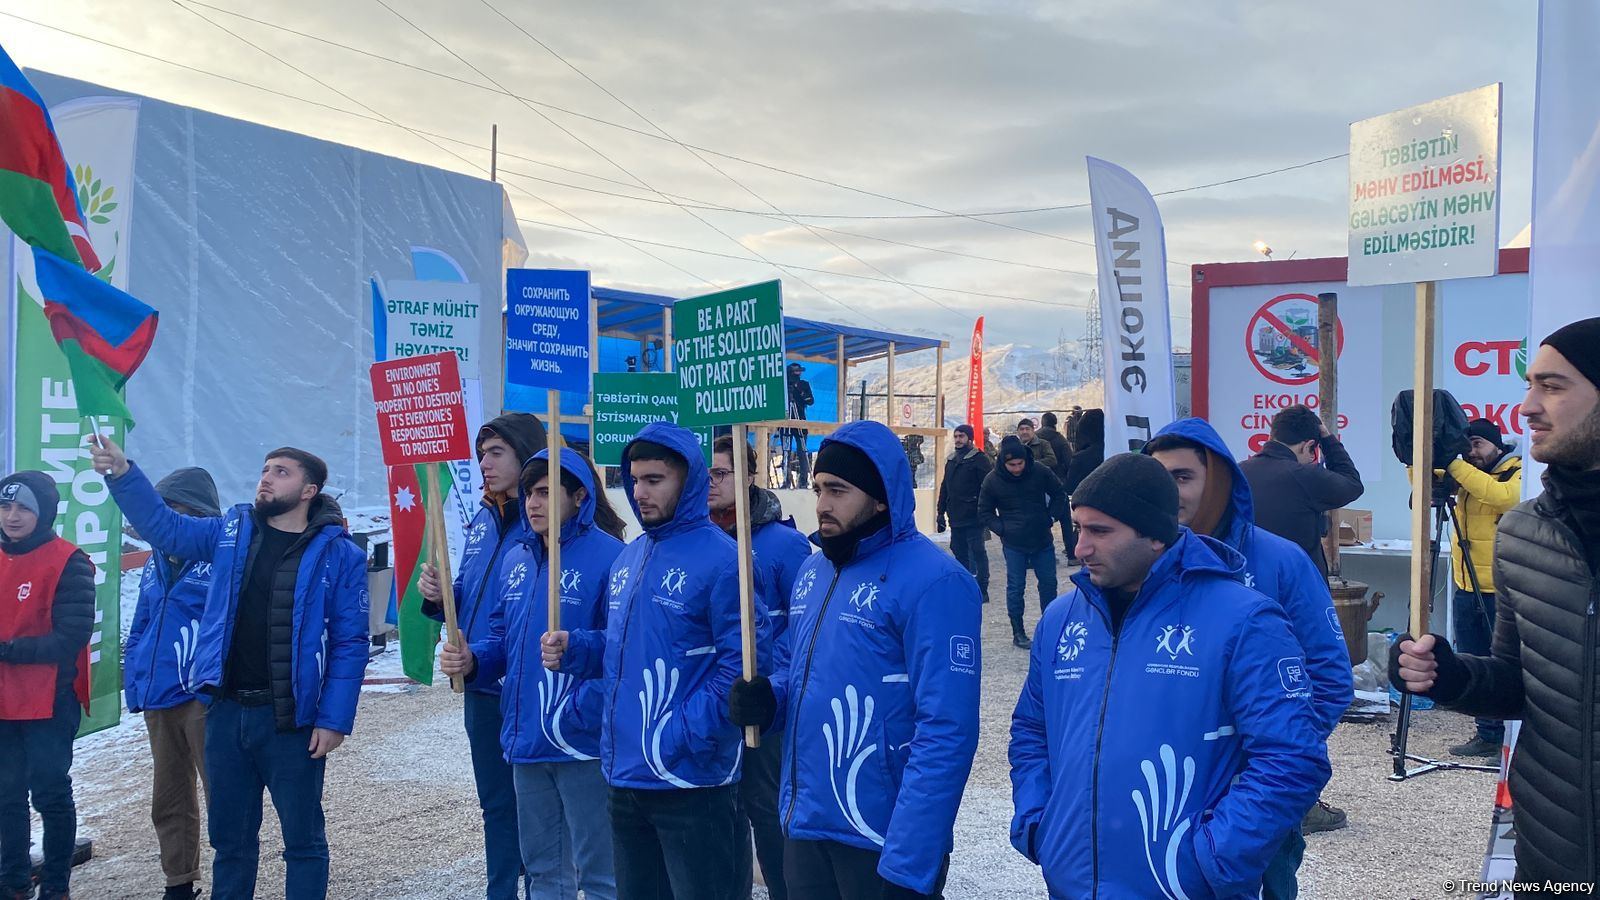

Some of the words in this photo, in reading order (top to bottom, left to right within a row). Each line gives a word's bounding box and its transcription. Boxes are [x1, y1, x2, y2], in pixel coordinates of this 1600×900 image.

[1380, 134, 1459, 168] TƏBİƏTİN
[1355, 177, 1398, 202] MƏHV
[1402, 154, 1489, 192] EDİLMƏSİ,
[1351, 196, 1438, 230] GƏLƏCƏYİN
[1443, 190, 1496, 217] MƏHV
[1364, 222, 1476, 256] EDİLMƏSİDİR!
[522, 286, 570, 300] СОХРАНИТЬ
[387, 300, 429, 315] ƏTRAF
[433, 300, 479, 318] MÜHİT
[514, 304, 579, 321] ОКРУЖАЮЩУЮ
[698, 307, 712, 332] BE
[716, 305, 724, 328] A
[726, 298, 758, 325] PART
[410, 321, 453, 338] TƏMİZ
[532, 322, 560, 339] СРЕДУ,
[508, 338, 538, 352] ЗНАЧИТ
[540, 342, 588, 358] СОХРАНИТЬ
[676, 338, 690, 363] OF
[693, 335, 716, 360] THE
[718, 322, 781, 357] SOLUTION
[386, 362, 440, 382] ENVIRONMENT
[530, 358, 562, 374] ЖИЗНЬ.
[680, 364, 704, 389] NOT
[706, 359, 736, 386] PART
[739, 356, 755, 382] OF
[758, 352, 783, 379] THE
[392, 384, 402, 396] IN
[403, 382, 414, 395] NO
[416, 378, 440, 392] ONE'S
[375, 398, 412, 414] PROPERTY
[412, 396, 424, 409] TO
[426, 391, 462, 408] DESTROY
[596, 392, 648, 404] TƏBİƏTİN
[696, 384, 768, 414] POLLUTION!
[389, 414, 404, 428] IT'S
[405, 408, 452, 425] EVERYONE'S
[391, 424, 454, 442] RESPONSIBILITY
[400, 444, 411, 456] TO
[412, 440, 449, 455] PROTECT!
